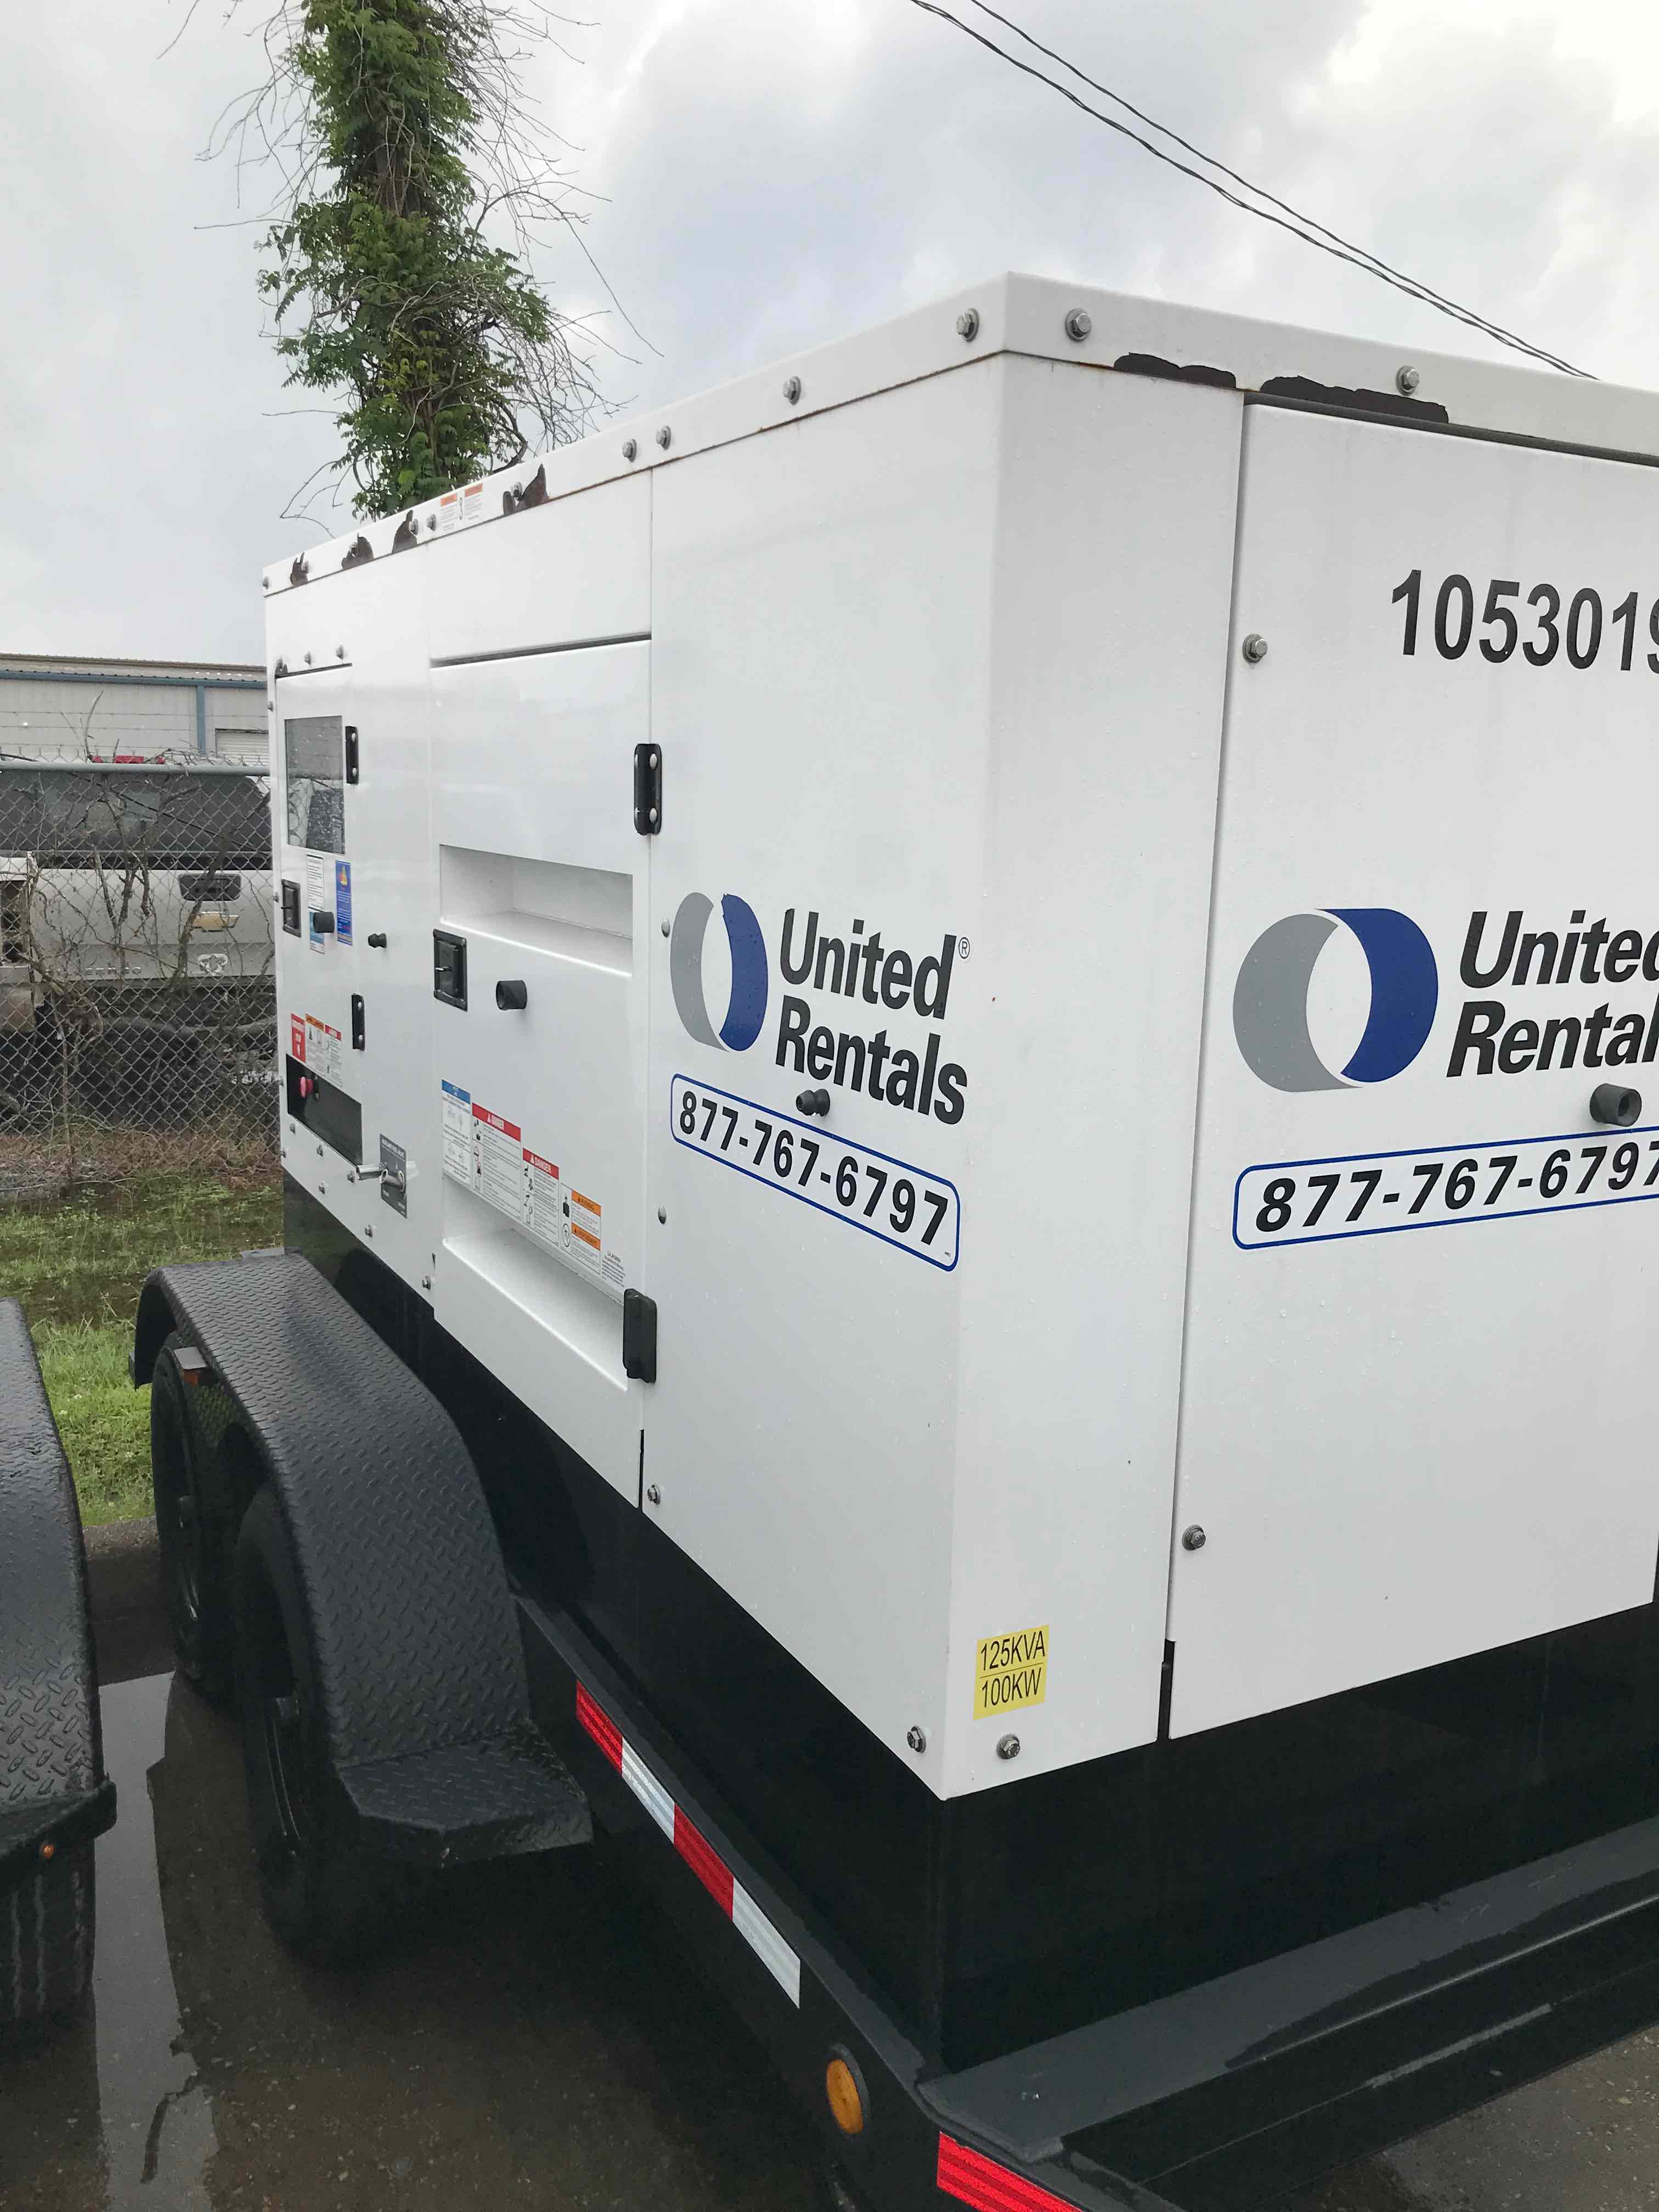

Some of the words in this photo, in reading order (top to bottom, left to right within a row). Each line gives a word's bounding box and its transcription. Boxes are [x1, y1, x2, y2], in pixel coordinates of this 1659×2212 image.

[781, 909, 956, 1019] United
[776, 995, 967, 1124] Rentals
[680, 1091, 948, 1245] 877-767-6797
[981, 1630, 1045, 1671] 125KVA
[981, 1667, 1042, 1708] 100KW
